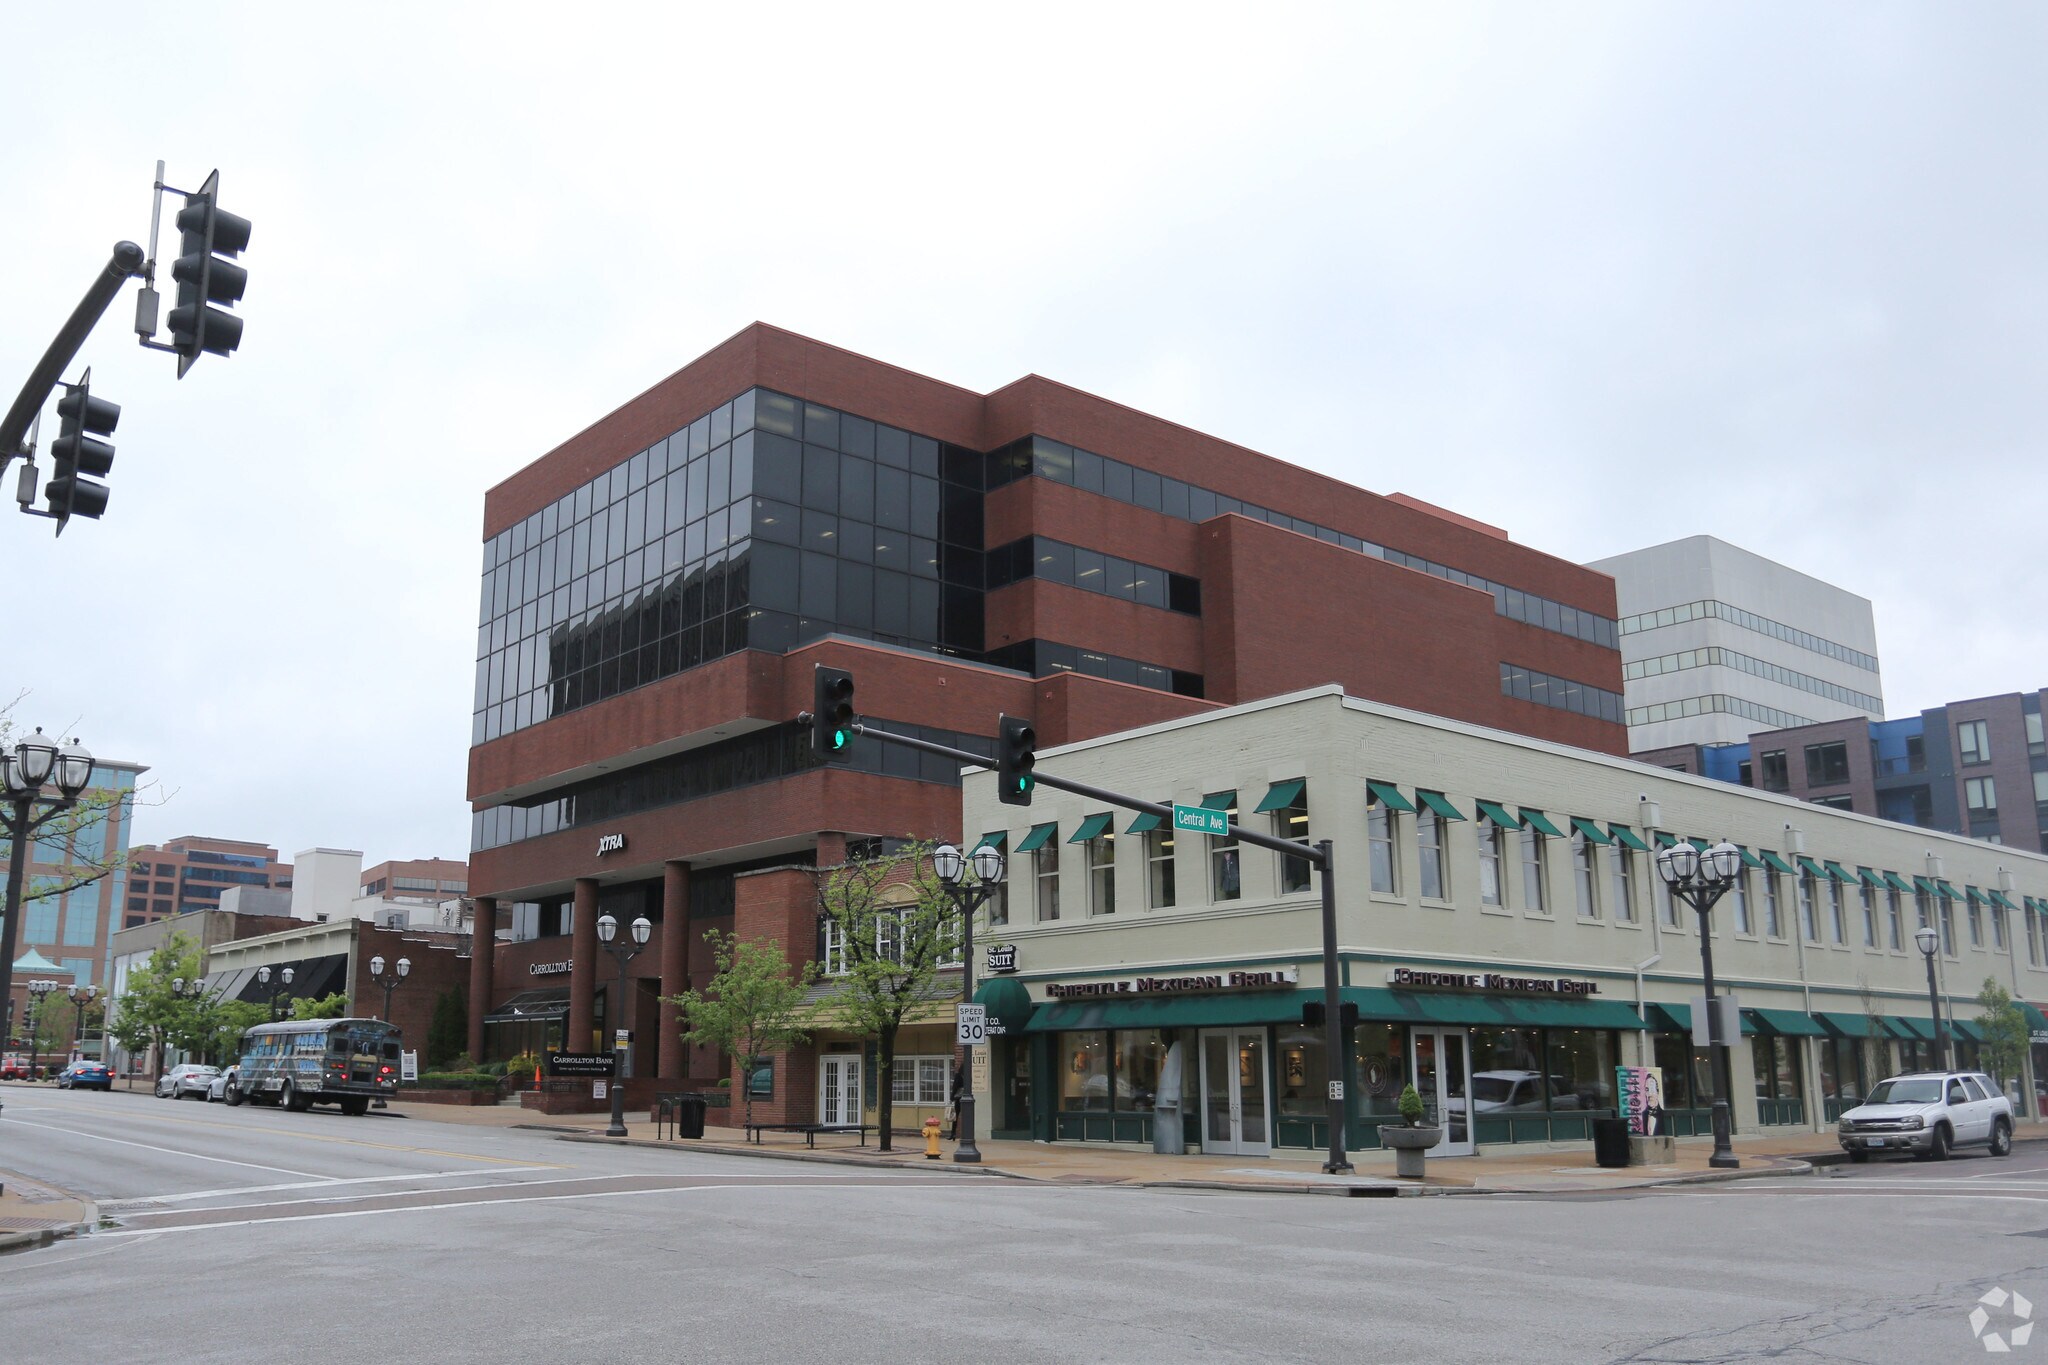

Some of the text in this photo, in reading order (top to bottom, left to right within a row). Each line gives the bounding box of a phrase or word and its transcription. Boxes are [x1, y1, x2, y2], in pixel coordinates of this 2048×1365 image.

[1178, 810, 1223, 830] Central Ave
[596, 833, 623, 857] XTRA
[530, 961, 568, 975] CARROLLTON
[989, 954, 1012, 966] SUIT
[1045, 971, 1289, 998] CHIPOTLE MEXICAN GRILL
[1398, 968, 1602, 994] CHIPOTLE MEXICAN GRILL
[961, 1024, 983, 1040] 30
[553, 1056, 594, 1064] CARROLLTON
[972, 1056, 986, 1064] UIT
